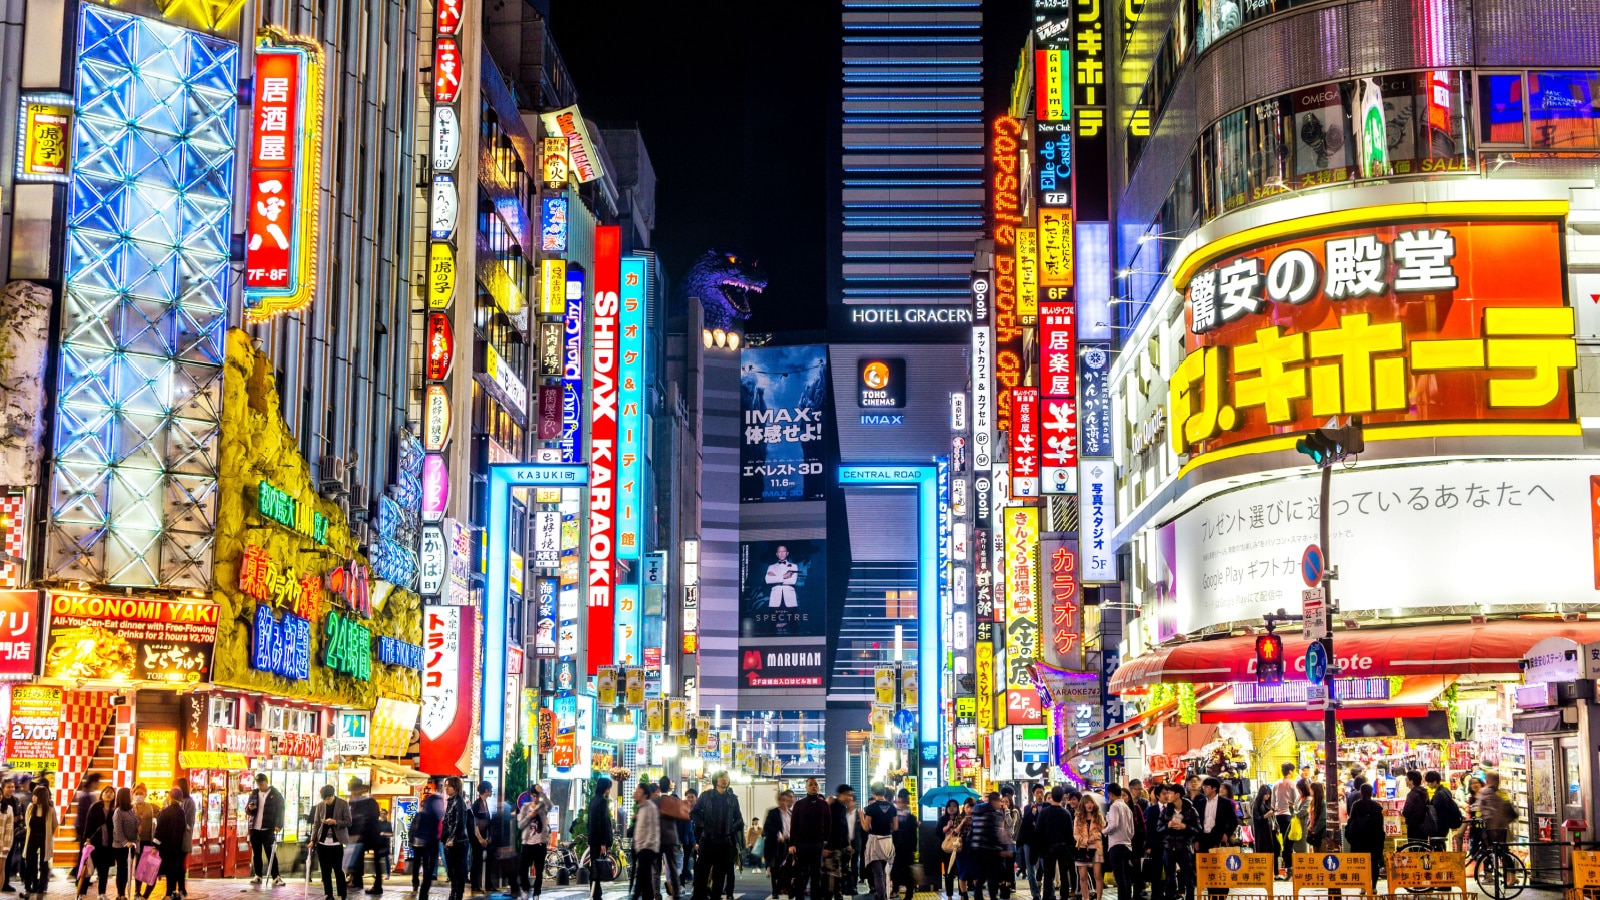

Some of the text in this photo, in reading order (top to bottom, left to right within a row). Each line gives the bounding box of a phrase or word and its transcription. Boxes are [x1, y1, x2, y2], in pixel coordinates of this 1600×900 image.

[1302, 90, 1340, 106] OMEGA
[30, 105, 49, 113] 4F
[258, 77, 289, 162] 居酒屋
[1038, 124, 1054, 132] New
[39, 126, 59, 159] 虎の子
[435, 160, 451, 168] 6F
[1056, 134, 1071, 177] Castle
[1422, 157, 1472, 172] SALE
[1041, 141, 1056, 190] Elle de
[1302, 166, 1347, 187] 大特価
[1048, 195, 1065, 203] 7F
[248, 179, 289, 251] つぼ八
[432, 261, 451, 293] 虎の子
[1190, 230, 1458, 334] 驚安の殿堂
[1048, 287, 1068, 300] 6F
[852, 308, 973, 323] HOTEL GRACERY
[1022, 316, 1035, 324] 6F
[1049, 332, 1070, 396] 居楽屋
[977, 331, 986, 426] ネットカフェ & カプセル
[862, 391, 887, 399] TOHO
[862, 398, 895, 406] CINEMAS
[431, 395, 443, 444] お好み焼き
[745, 407, 822, 424] IMAXで
[860, 415, 903, 425] IMAX
[955, 400, 963, 426] 東京ビル
[1020, 403, 1030, 432] 居楽屋
[1084, 371, 1100, 453] かんかん商店
[744, 424, 822, 445] 体感せよ!
[590, 291, 619, 608] SHIDAX KARAOKE
[978, 434, 987, 464] 8F 5F
[743, 462, 823, 477] エベレスト 3D
[843, 470, 922, 479] CENTRAL ROAD
[429, 459, 443, 509] プリクラ
[542, 491, 555, 499] 3F
[1091, 484, 1105, 550] 写真スタジオ
[423, 540, 439, 577] かっぱ
[1014, 512, 1030, 595] きんくら酒場
[1091, 555, 1107, 570] 5F
[424, 581, 437, 589] B1
[1202, 565, 1244, 590] Google Play
[539, 582, 553, 616] 海の家
[975, 570, 992, 617] 甘太郎
[1052, 547, 1078, 654] カラオケ
[53, 597, 219, 623] OKONOMI YAKI
[755, 613, 809, 622] SPECTRE
[53, 616, 215, 634] All-You-Can-Eat dinner with Free-Flowing
[978, 622, 991, 631] 4F
[117, 629, 215, 643] Drinks for 2 hours ¥2,700
[978, 631, 991, 639] 3F
[426, 613, 445, 688] トラノコ
[767, 652, 822, 667] MARUHAN
[1009, 617, 1039, 686] 金の蔵
[644, 669, 660, 678] Cafe
[1309, 651, 1318, 678] P
[1010, 691, 1031, 709] 2F
[1052, 688, 1087, 696] KARAOKE
[340, 743, 367, 752] 虎の子
[1107, 743, 1124, 756] B1
